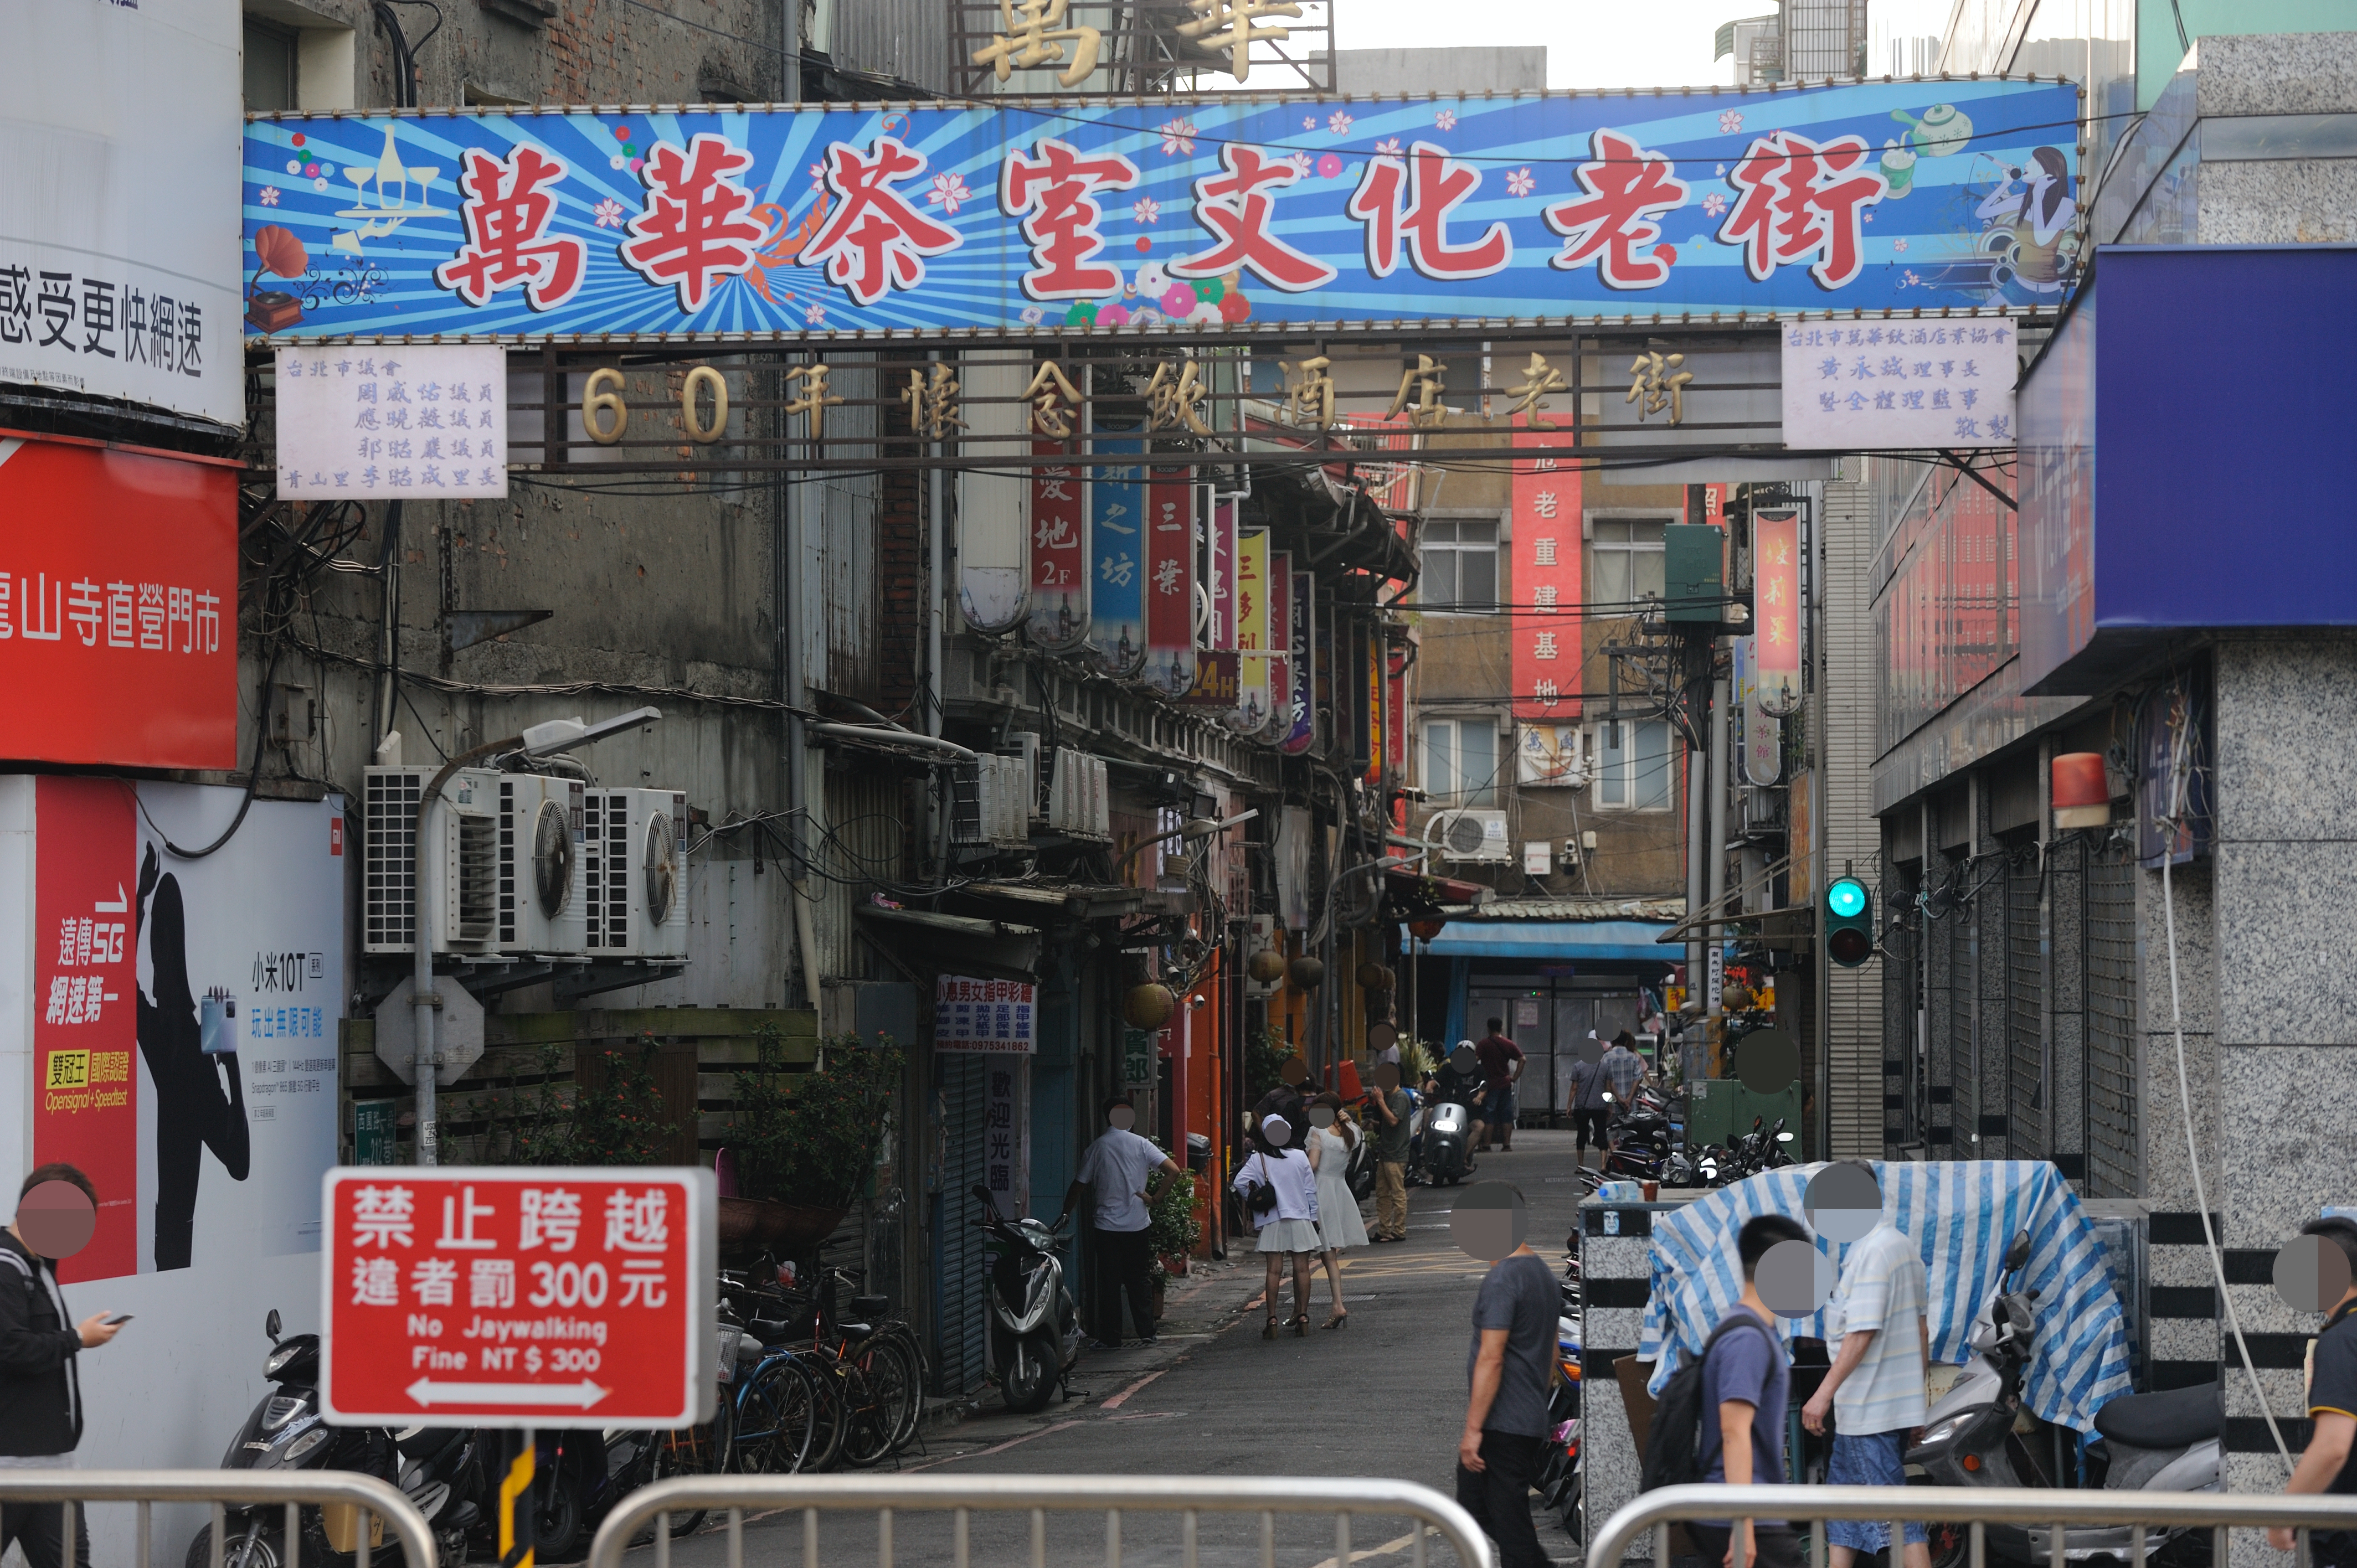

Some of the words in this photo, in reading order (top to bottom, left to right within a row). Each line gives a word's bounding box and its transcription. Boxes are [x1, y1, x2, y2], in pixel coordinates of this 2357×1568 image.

[435, 128, 1890, 314] 萬華茶室文化老街
[0, 264, 202, 378] 感受更快網速
[1787, 327, 2011, 347] 台北市萬華飲酒店業協會
[0, 365, 85, 387] 終端設備及地點等因素而影響
[286, 358, 402, 377] 台北市議會
[357, 380, 493, 404] 周威佑議員
[582, 350, 1694, 443] 60年懷念飲酒店老街
[1819, 388, 1979, 412] 暨全體理監事
[354, 406, 493, 431] 應曉薇議員
[1954, 414, 2011, 439] 敬製
[1041, 560, 1070, 585] 2F
[1533, 443, 1557, 707] 危老重建基地
[252, 951, 305, 993] 小米10T
[45, 974, 119, 1025] 網速第一
[936, 980, 1033, 1003] 小惠男女指甲彩繪
[251, 1006, 322, 1038] 玩出無限可能
[936, 1040, 1028, 1051] 預約電話:0975341862
[51, 1053, 85, 1086] 雙冠王
[90, 1050, 130, 1083] 國際認證
[45, 1089, 90, 1115] Opensignal
[95, 1087, 128, 1112] Speedtest
[990, 1070, 1011, 1192] 歡迎光臨
[352, 1185, 668, 1253] 禁止跨越
[351, 1256, 667, 1309] 違者罰300元
[408, 1313, 443, 1337] No
[464, 1314, 607, 1347] Jaywalking
[413, 1346, 467, 1370] Fine
[550, 1348, 601, 1372] 300
